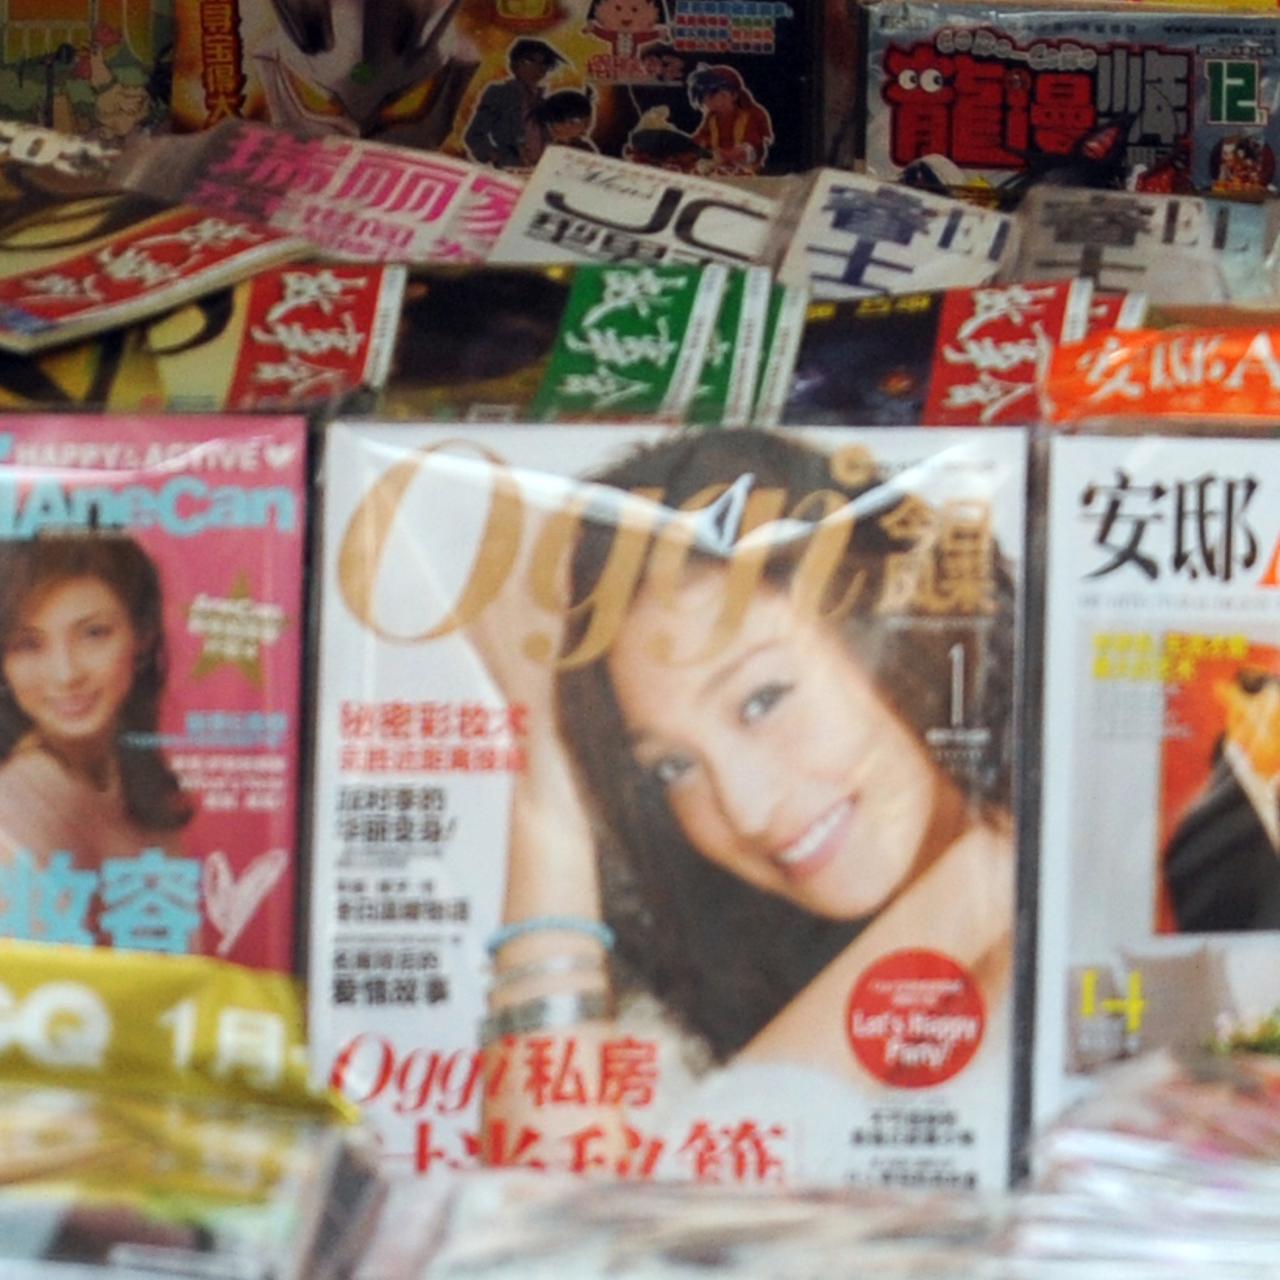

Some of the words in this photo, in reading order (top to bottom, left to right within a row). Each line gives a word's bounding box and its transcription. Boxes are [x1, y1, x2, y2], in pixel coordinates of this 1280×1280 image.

[251, 267, 369, 402] 故事会
[556, 266, 690, 407] 故事会
[524, 1035, 662, 1109] 私房
